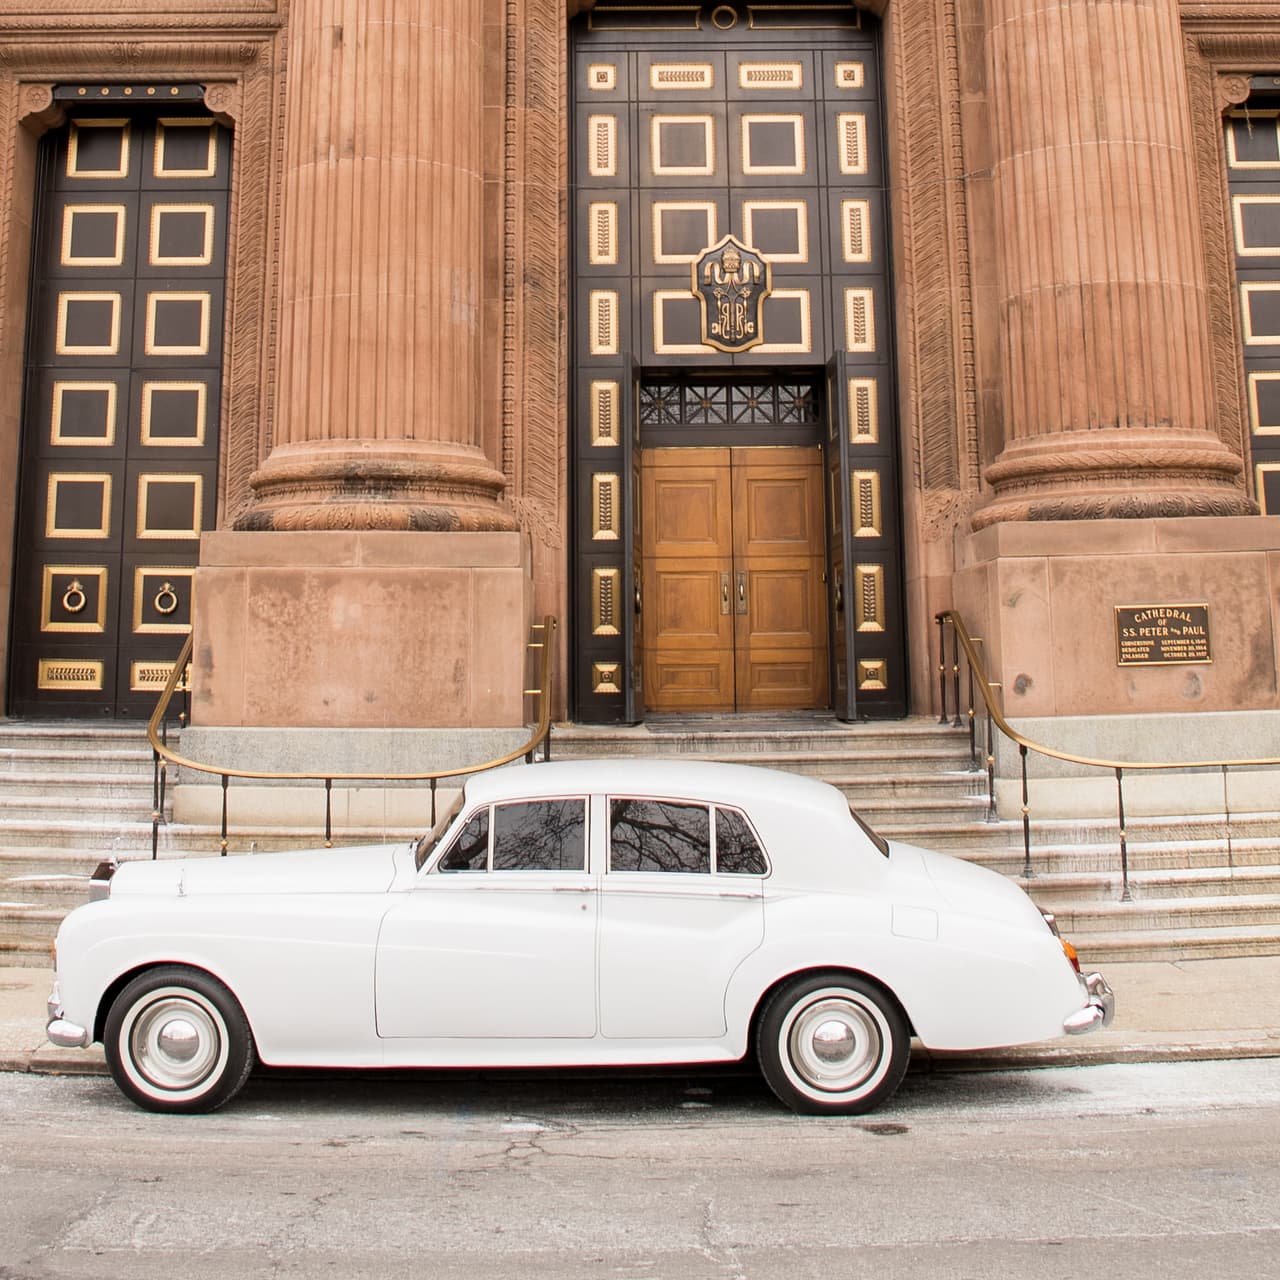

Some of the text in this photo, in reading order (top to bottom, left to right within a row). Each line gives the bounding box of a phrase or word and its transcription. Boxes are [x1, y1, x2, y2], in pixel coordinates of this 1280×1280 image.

[1134, 608, 1192, 623] CATHEDRAL
[1157, 618, 1166, 626] OF
[1139, 626, 1169, 636] PETER
[1182, 626, 1205, 635] PAUL
